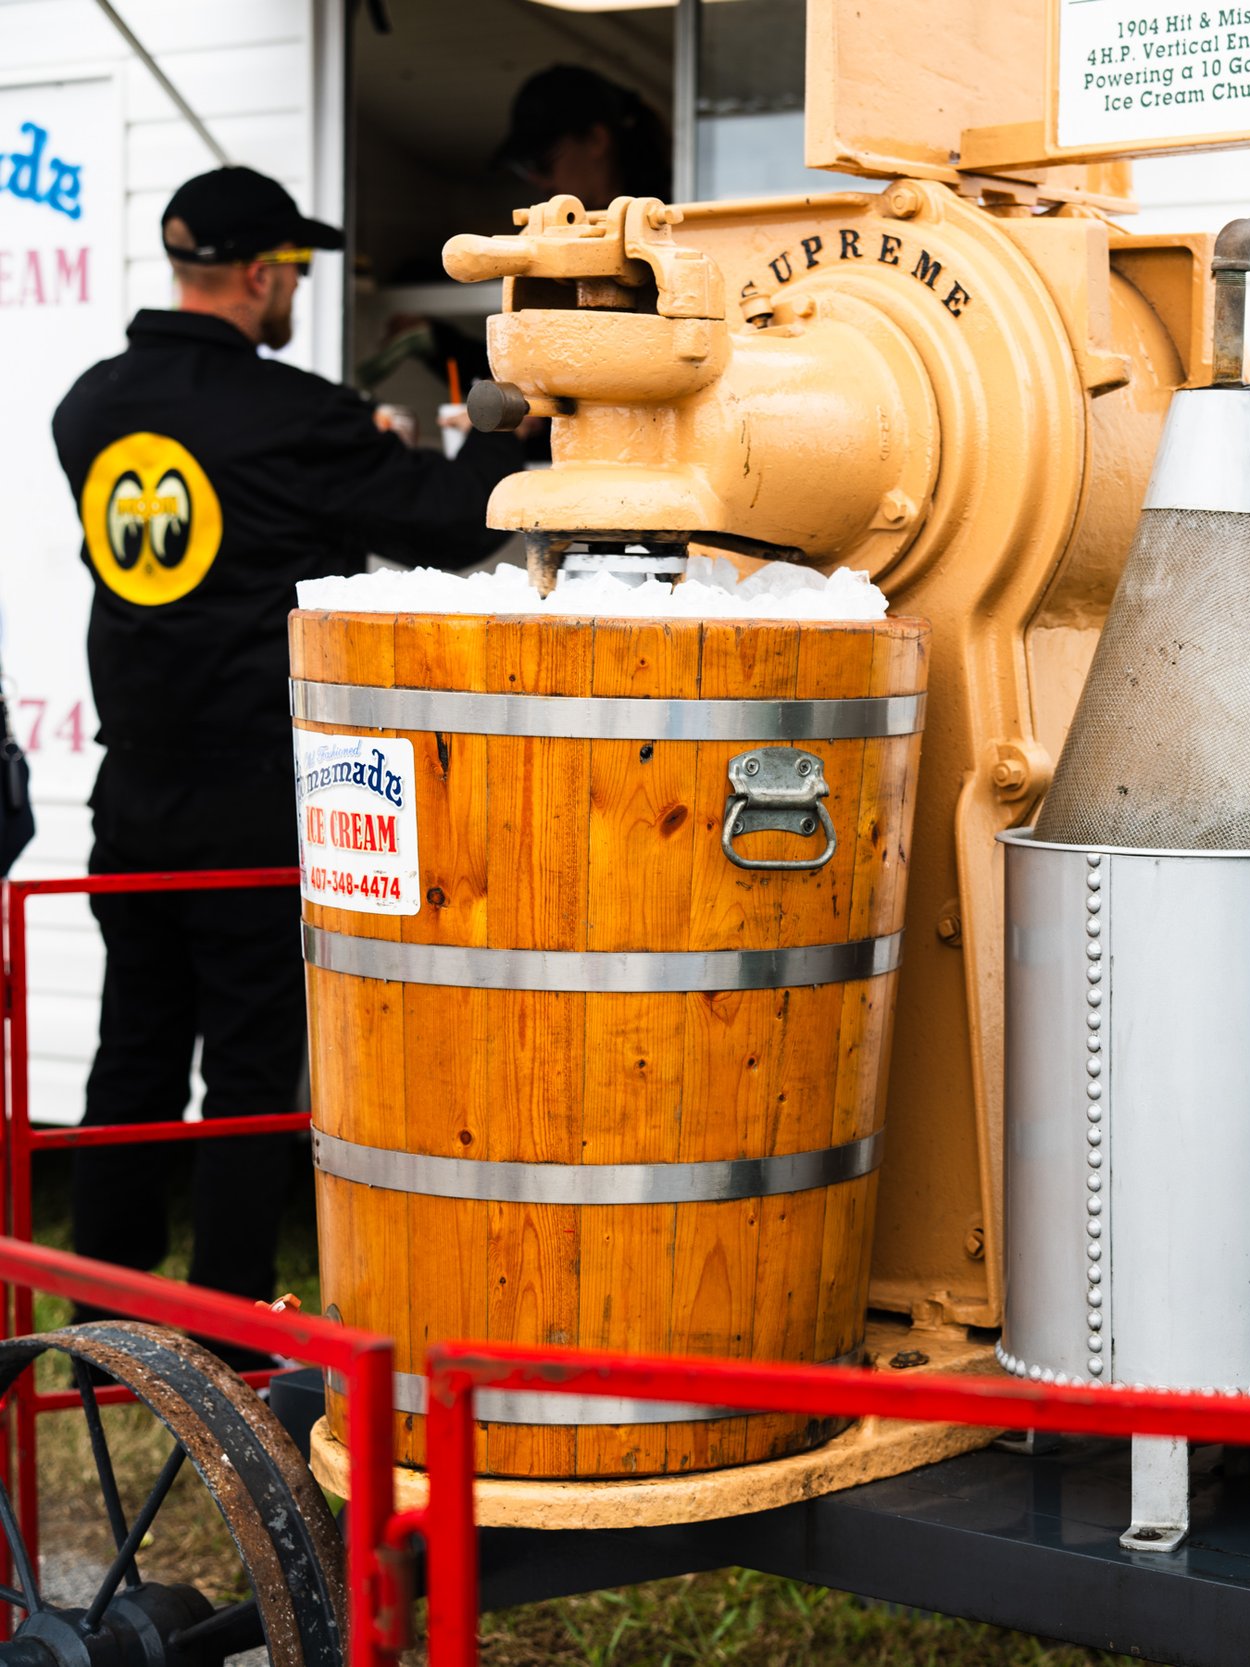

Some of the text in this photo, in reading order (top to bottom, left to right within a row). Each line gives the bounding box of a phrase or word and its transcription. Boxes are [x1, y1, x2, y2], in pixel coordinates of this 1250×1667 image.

[1117, 19, 1159, 39] 1904
[1166, 15, 1192, 33] Hit
[1199, 12, 1211, 29] &
[1143, 36, 1219, 60] Vertical
[1084, 66, 1174, 90] Powering
[1181, 66, 1193, 80] a
[1202, 59, 1221, 78] 10
[1104, 95, 1133, 111] Ice
[1140, 89, 1205, 108] Cream
[296, 748, 402, 807] memade
[306, 806, 397, 853] ICE CREAM
[311, 866, 401, 900] 407-348-4474
